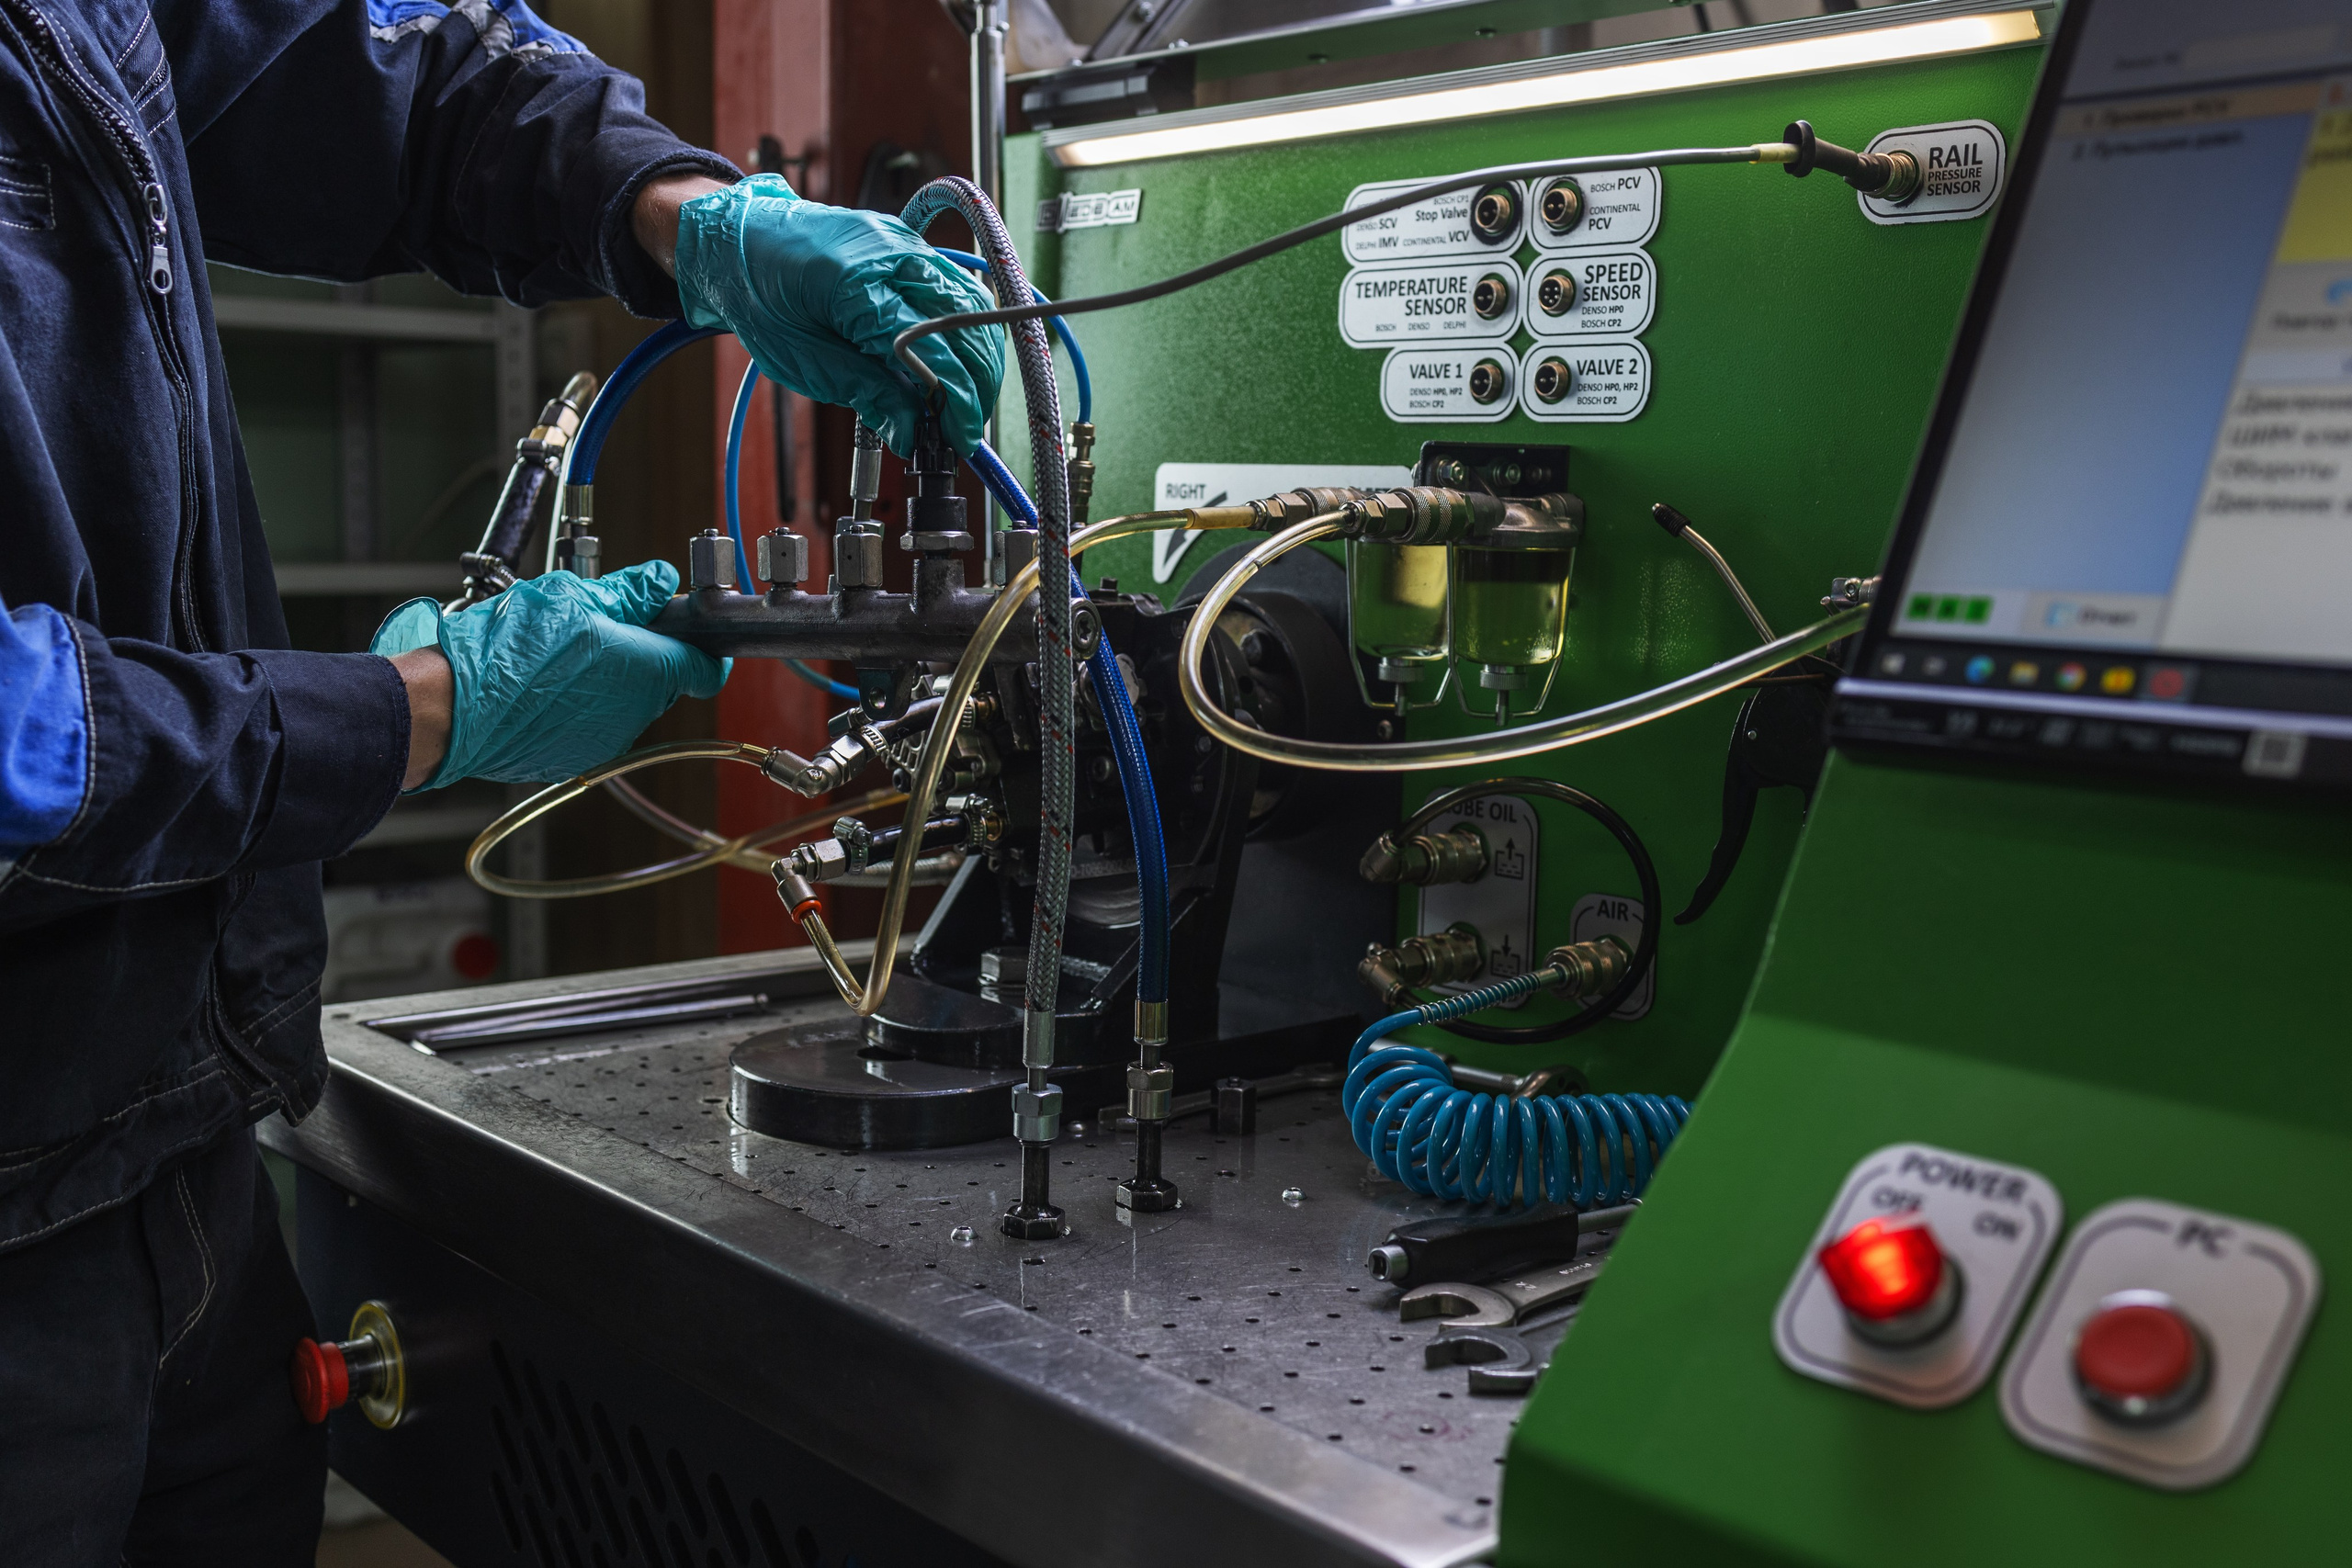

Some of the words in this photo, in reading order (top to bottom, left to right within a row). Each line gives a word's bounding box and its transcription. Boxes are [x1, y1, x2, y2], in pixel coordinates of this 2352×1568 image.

[1928, 142, 1983, 169] RAIL
[1928, 167, 1982, 182] PRESSURE
[1590, 183, 1615, 193] BOSCH
[1618, 175, 1641, 190] PCV
[1927, 180, 1981, 196] SENSOR
[1416, 209, 1438, 222] Stop
[1441, 207, 1468, 220] Valve
[1589, 203, 1641, 215] CONTINENTAL
[1379, 218, 1397, 230] SCV
[1589, 217, 1611, 231] PCV
[1378, 236, 1399, 248] IMV
[1403, 235, 1446, 246] CONTINENTAL
[1449, 230, 1470, 243] VCV
[1584, 262, 1643, 284] SPEED
[1356, 276, 1468, 299] TEMPERATURE
[1582, 284, 1641, 302] SENSOR
[1405, 297, 1467, 317] SENSOR
[1581, 306, 1607, 315] DENSO
[1581, 320, 1606, 329] BOSCH
[1607, 318, 1622, 328] CP2
[1409, 363, 1451, 379] VALVE
[1455, 363, 1463, 378] 1
[1577, 358, 1624, 376] VALVE
[1629, 358, 1638, 375] 2
[1577, 383, 1603, 392] DENSO
[1623, 382, 1638, 391] HP2
[1577, 396, 1601, 405] BOSCH
[1603, 396, 1618, 405] CP2
[1165, 483, 1206, 500] RIGHT
[1489, 802, 1518, 823] OIL
[1597, 900, 1629, 921] AIR
[1899, 1152, 2029, 1202] POWER
[1871, 1185, 1923, 1213] OFF
[1973, 1210, 2021, 1242] ON
[2175, 1218, 2233, 1258] PC
